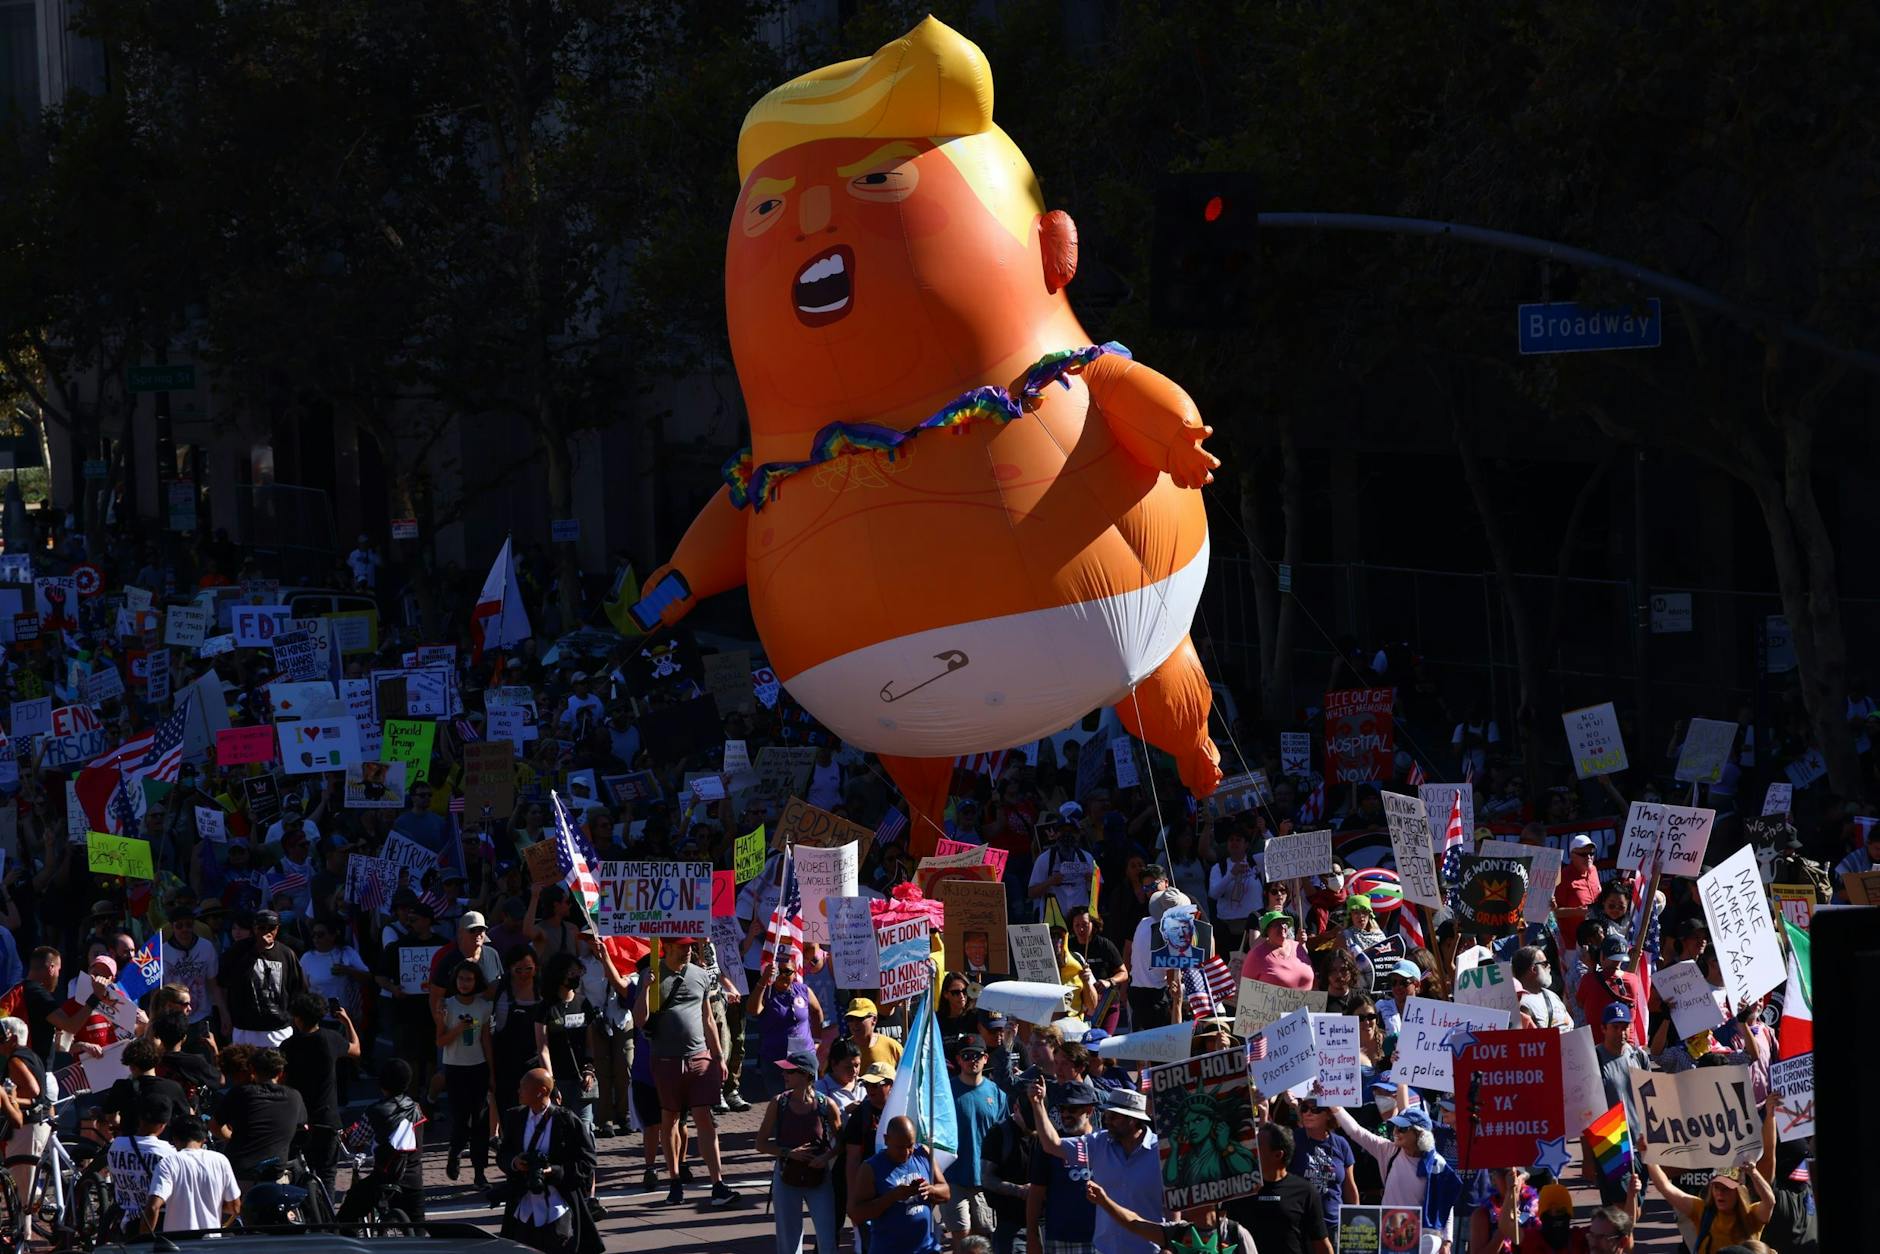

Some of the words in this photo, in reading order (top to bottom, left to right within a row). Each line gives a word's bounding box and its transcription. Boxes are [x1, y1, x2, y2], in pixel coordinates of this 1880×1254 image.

[1529, 312, 1649, 338] Broadway
[57, 577, 75, 588] ICE
[1351, 688, 1372, 704] OUT
[1372, 688, 1387, 701] OF
[16, 702, 45, 721] FDT
[388, 722, 424, 737] Donald
[1326, 733, 1392, 758] HOSPITAL
[1336, 764, 1381, 784] NOW
[785, 804, 830, 836] GOD
[1636, 805, 1658, 821] This
[1667, 826, 1687, 841] for
[600, 862, 617, 877] AN
[622, 862, 680, 878] AMERICA
[685, 863, 711, 878] FOR
[1707, 877, 1733, 939] THINK
[1735, 868, 1766, 934] MAKE
[612, 912, 626, 920] our
[630, 911, 662, 920] DREAM
[612, 922, 637, 934] their
[639, 920, 705, 934] NIGHTMARE
[878, 928, 896, 948] WE
[898, 920, 930, 943] DON'T
[1722, 885, 1754, 966] AMERICA
[1015, 935, 1047, 947] NATIONAL
[1155, 956, 1200, 969] NOPE
[880, 968, 896, 988] DO
[896, 958, 932, 983] KINGS
[880, 988, 890, 1002] IN
[1250, 980, 1266, 993] THE
[1277, 989, 1307, 1000] ONLY
[1404, 1003, 1424, 1024] Life
[1431, 1007, 1462, 1028] Libert
[1277, 1019, 1297, 1039] NOT
[1301, 1016, 1308, 1026] A
[1319, 1022, 1326, 1035] E
[1329, 1023, 1354, 1037] pluribus
[1267, 1045, 1289, 1062] PAID
[1318, 1051, 1335, 1068] Stay
[1337, 1054, 1356, 1066] strong
[1472, 1044, 1508, 1060] LOVE
[1518, 1041, 1547, 1058] THY
[1153, 1064, 1198, 1092] GIRL,
[1201, 1050, 1247, 1079] HOLD
[1262, 1044, 1316, 1085] PROTESTER!
[1400, 1066, 1407, 1076] a
[1411, 1062, 1445, 1083] police
[1772, 1065, 1782, 1076] NO
[1782, 1055, 1813, 1073] THRONES
[1319, 1069, 1342, 1082] Stand
[1345, 1072, 1354, 1083] up
[1773, 1075, 1783, 1087] NO
[1320, 1085, 1340, 1097] Speak
[1343, 1087, 1356, 1096] out
[1638, 1079, 1754, 1156] Enough!
[1474, 1119, 1549, 1137] A##HOLES
[1167, 1187, 1189, 1210] MY
[1192, 1170, 1261, 1206] EARRINGS
